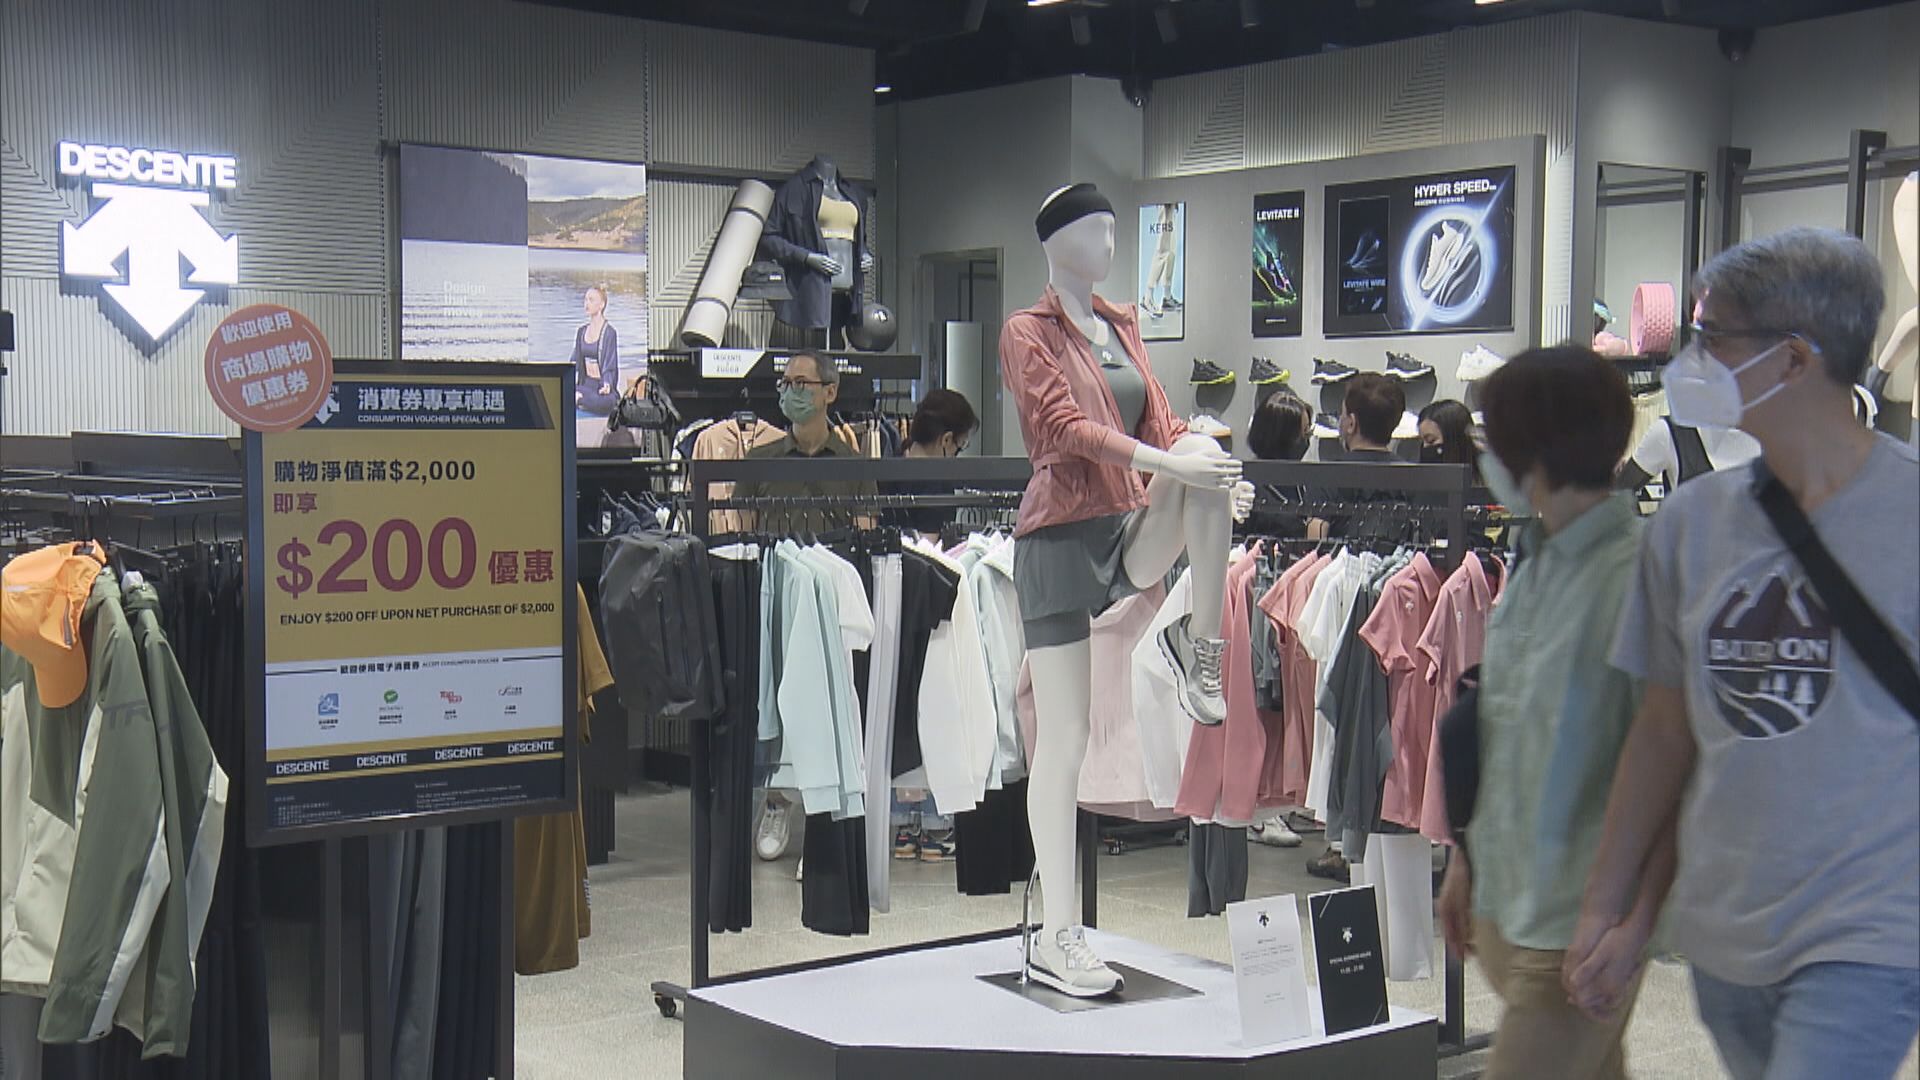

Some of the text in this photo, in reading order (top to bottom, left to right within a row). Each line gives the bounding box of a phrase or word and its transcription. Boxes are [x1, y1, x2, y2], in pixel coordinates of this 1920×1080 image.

[59, 142, 238, 189] DESCENTE
[1414, 183, 1451, 198] HYPER
[1256, 209, 1293, 221] LEVITATE
[1149, 222, 1174, 234] KERS
[220, 311, 293, 345] 歡迎使用
[220, 340, 313, 383] 商場購物
[241, 369, 310, 407] 優惠券
[358, 388, 505, 412] 消費券專享禮遇
[357, 415, 505, 424] CONSUMPTION VOUCHER SPECIAL OFFER
[274, 460, 476, 485] 購物淨值滿$2,000
[273, 493, 318, 514] 即享
[276, 517, 554, 599] $200 優惠
[280, 602, 554, 625] ENJOY $200 OFF UPON NET PURCHASE OF $2,000
[276, 740, 554, 775] DESCENTE DESCENTE DESCENTE DESCENTE
